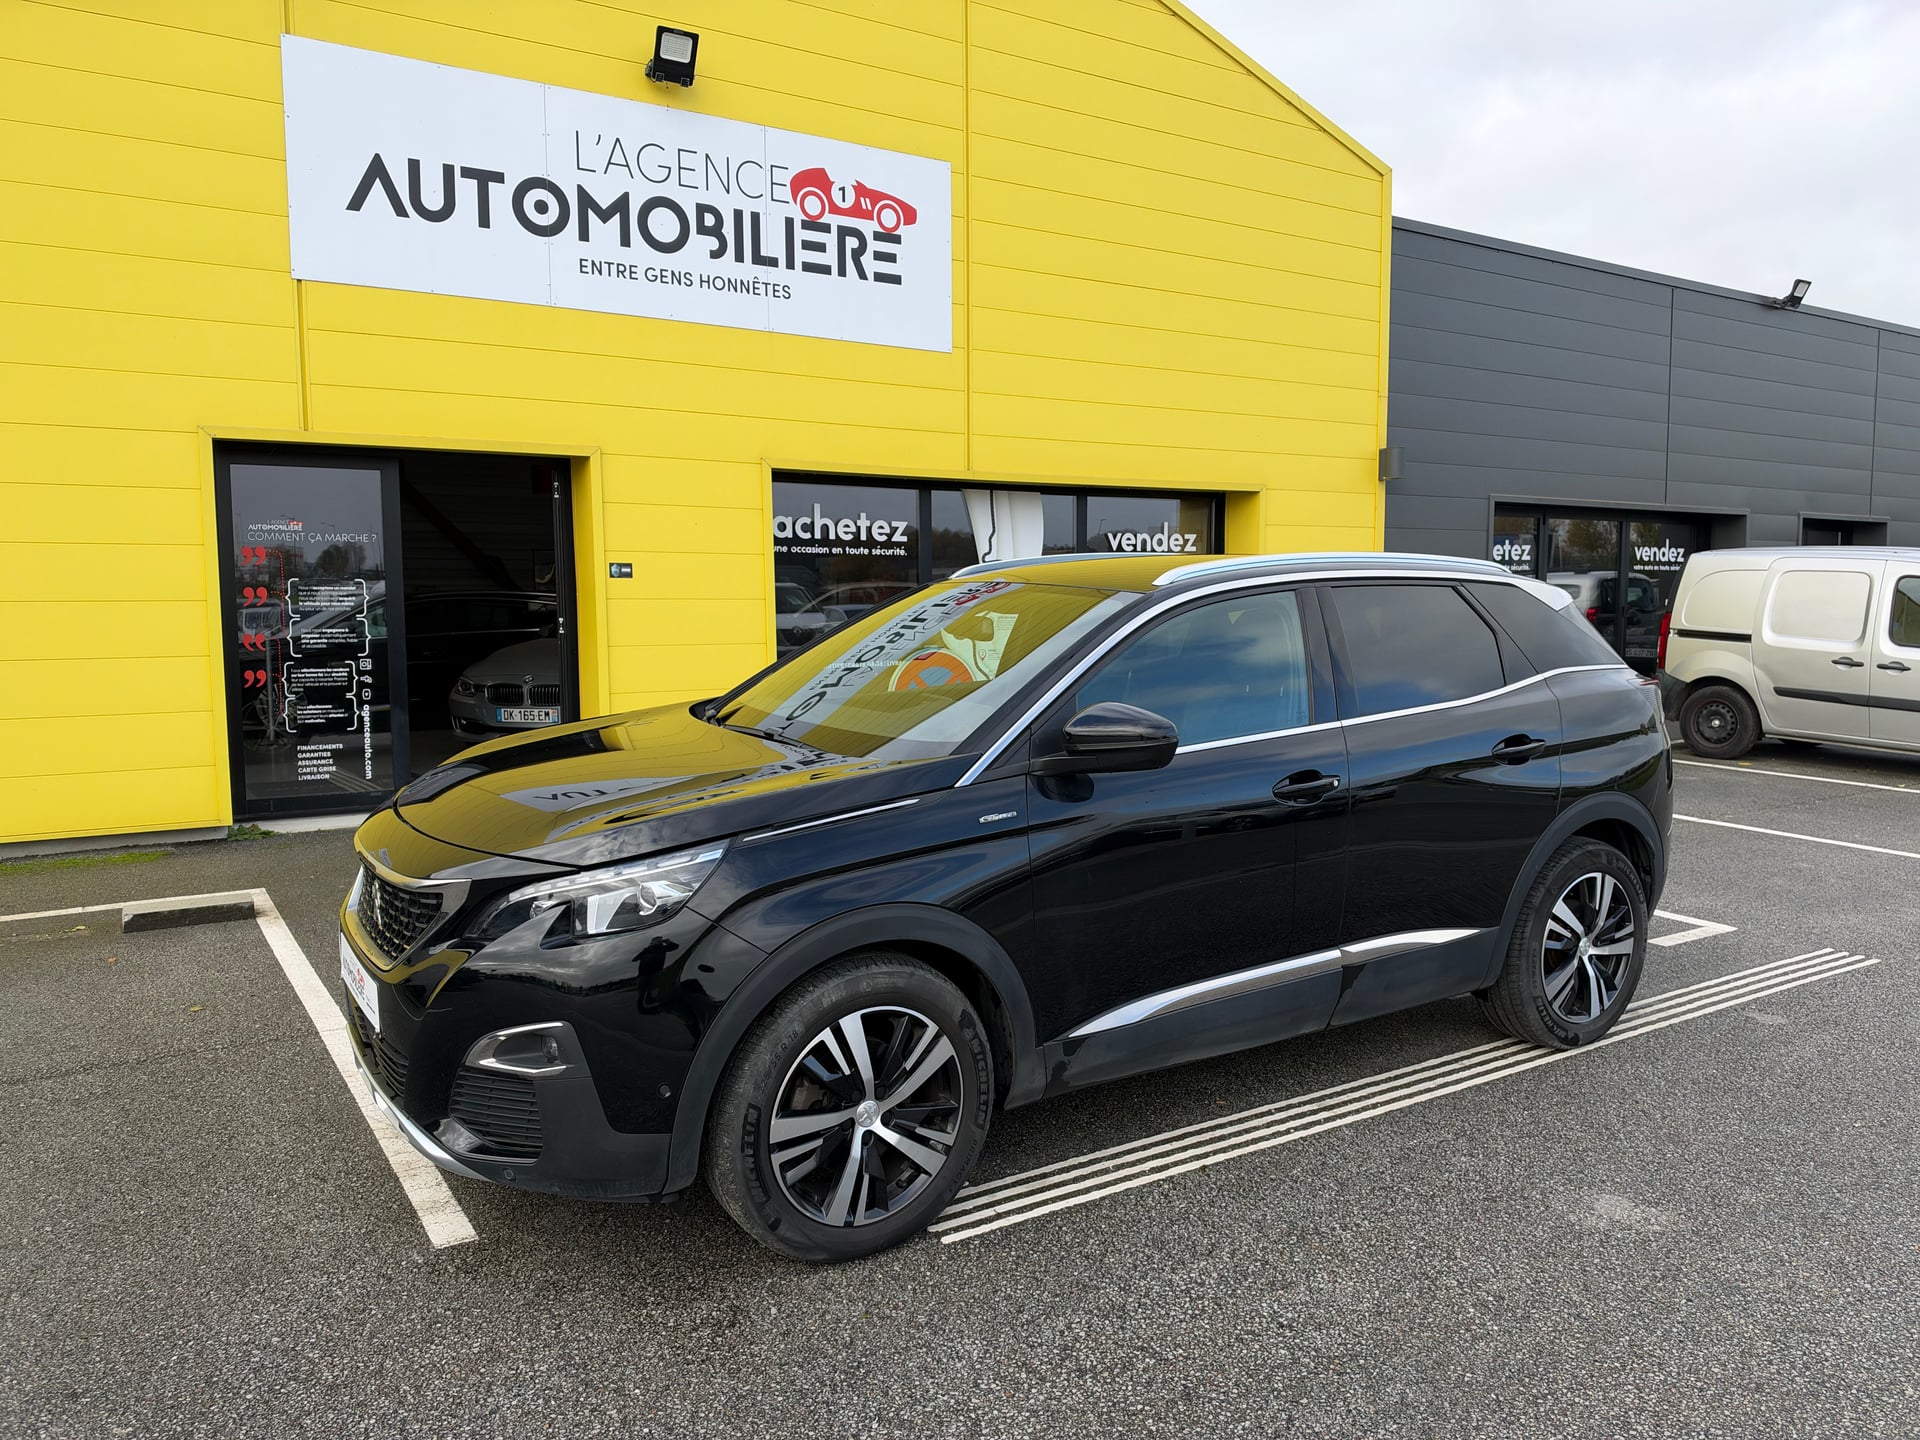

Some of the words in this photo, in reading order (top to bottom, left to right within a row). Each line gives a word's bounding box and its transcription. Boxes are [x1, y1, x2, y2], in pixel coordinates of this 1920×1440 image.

[576, 129, 791, 204] L'AGENCE
[837, 185, 847, 203] 1
[579, 258, 639, 281] ENTRE
[644, 266, 694, 288] GENS
[699, 275, 792, 300] HONNÊTES
[773, 503, 908, 542] achetez
[247, 531, 306, 541] COMMENT
[308, 533, 323, 543] ÇA
[324, 533, 369, 543] MARCHE
[371, 534, 377, 542] ?
[790, 544, 830, 554] occasion
[831, 547, 843, 555] en
[845, 546, 870, 555] toute
[871, 546, 908, 556] sécurité.
[1107, 521, 1198, 552] vendez
[1634, 538, 1685, 562] vendez
[297, 743, 344, 751] FINANCEMENTS
[361, 704, 373, 780] agenceauto.com
